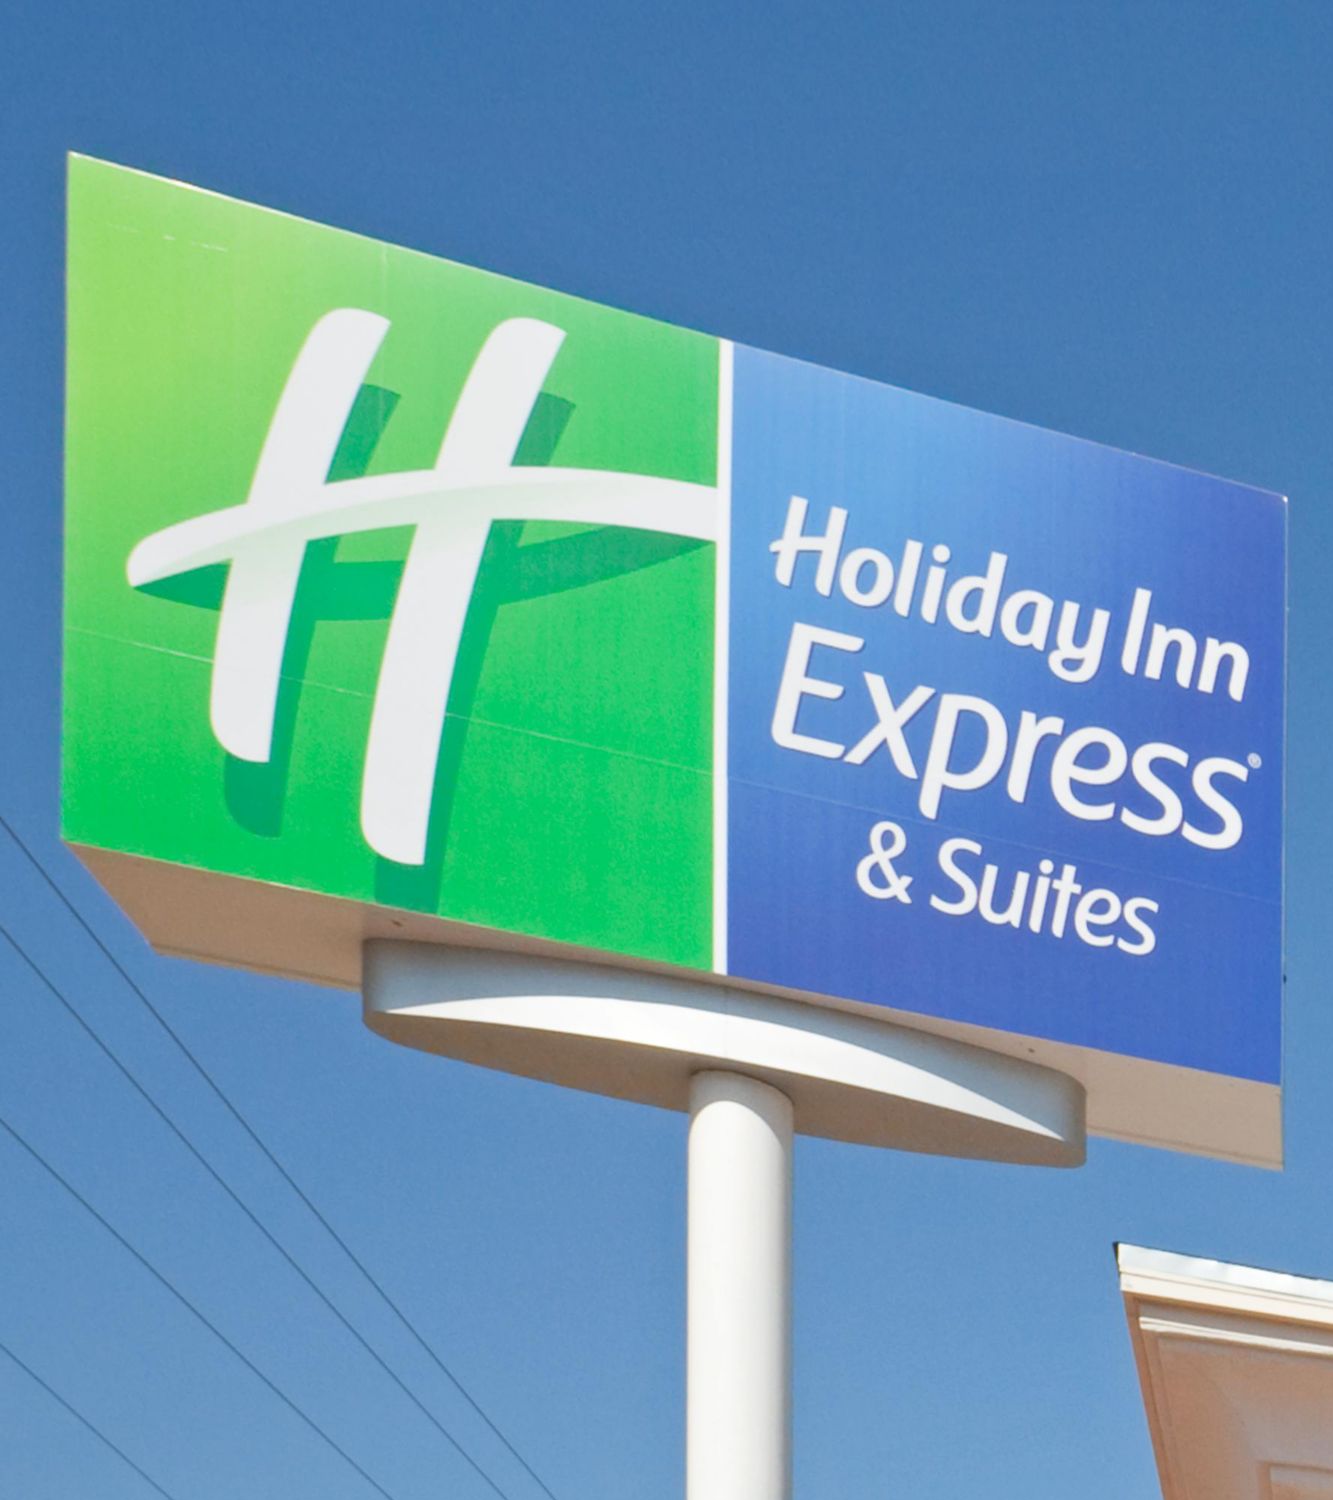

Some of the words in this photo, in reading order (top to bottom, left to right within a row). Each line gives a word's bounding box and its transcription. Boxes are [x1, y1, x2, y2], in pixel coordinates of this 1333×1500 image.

[769, 495, 1111, 683] Holiday
[1121, 587, 1251, 702] Inn
[770, 621, 1250, 851] Express
[855, 820, 914, 905] &
[930, 837, 1160, 956] Suites
